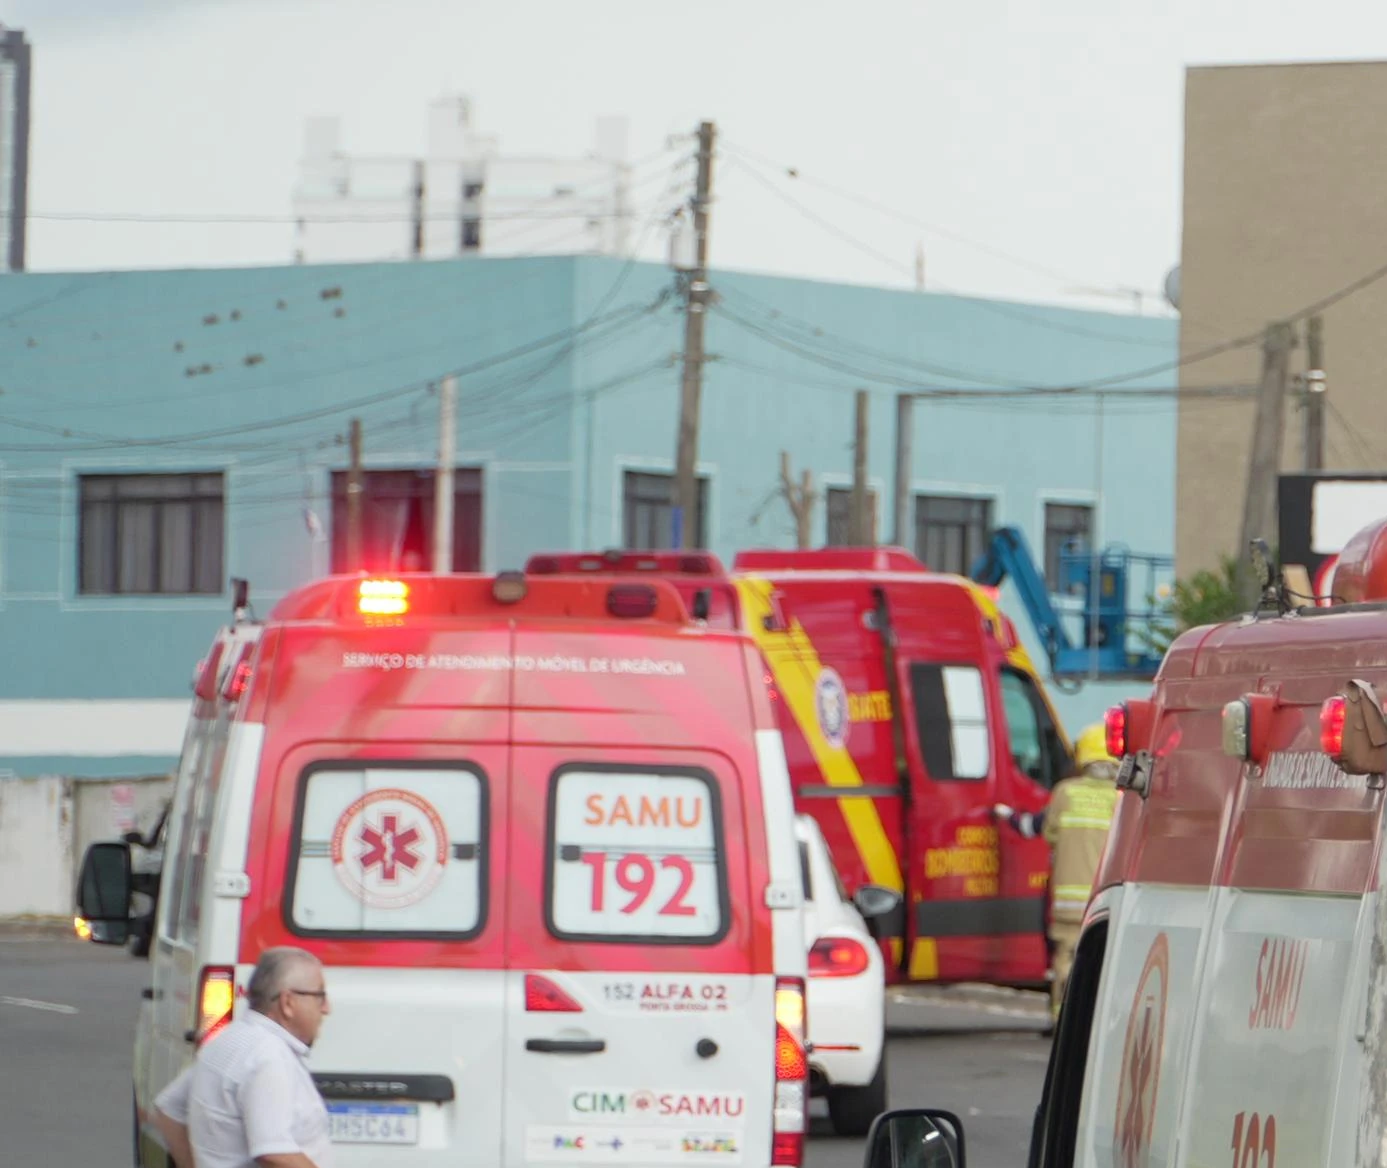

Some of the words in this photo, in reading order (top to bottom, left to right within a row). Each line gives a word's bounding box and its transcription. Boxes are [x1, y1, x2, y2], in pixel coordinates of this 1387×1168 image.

[342, 653, 402, 671] SERVIÇO
[428, 655, 536, 671] ATENDIMENTO
[538, 654, 587, 672] MÓVEL
[612, 658, 686, 675] URGÊNCIA
[585, 795, 702, 829] SAMU
[581, 852, 697, 917] 192
[641, 984, 693, 999] ALFA
[701, 985, 727, 999] 02
[1248, 937, 1309, 1030] SAMU
[573, 1092, 625, 1113] CIM
[659, 1096, 743, 1117] SAMU
